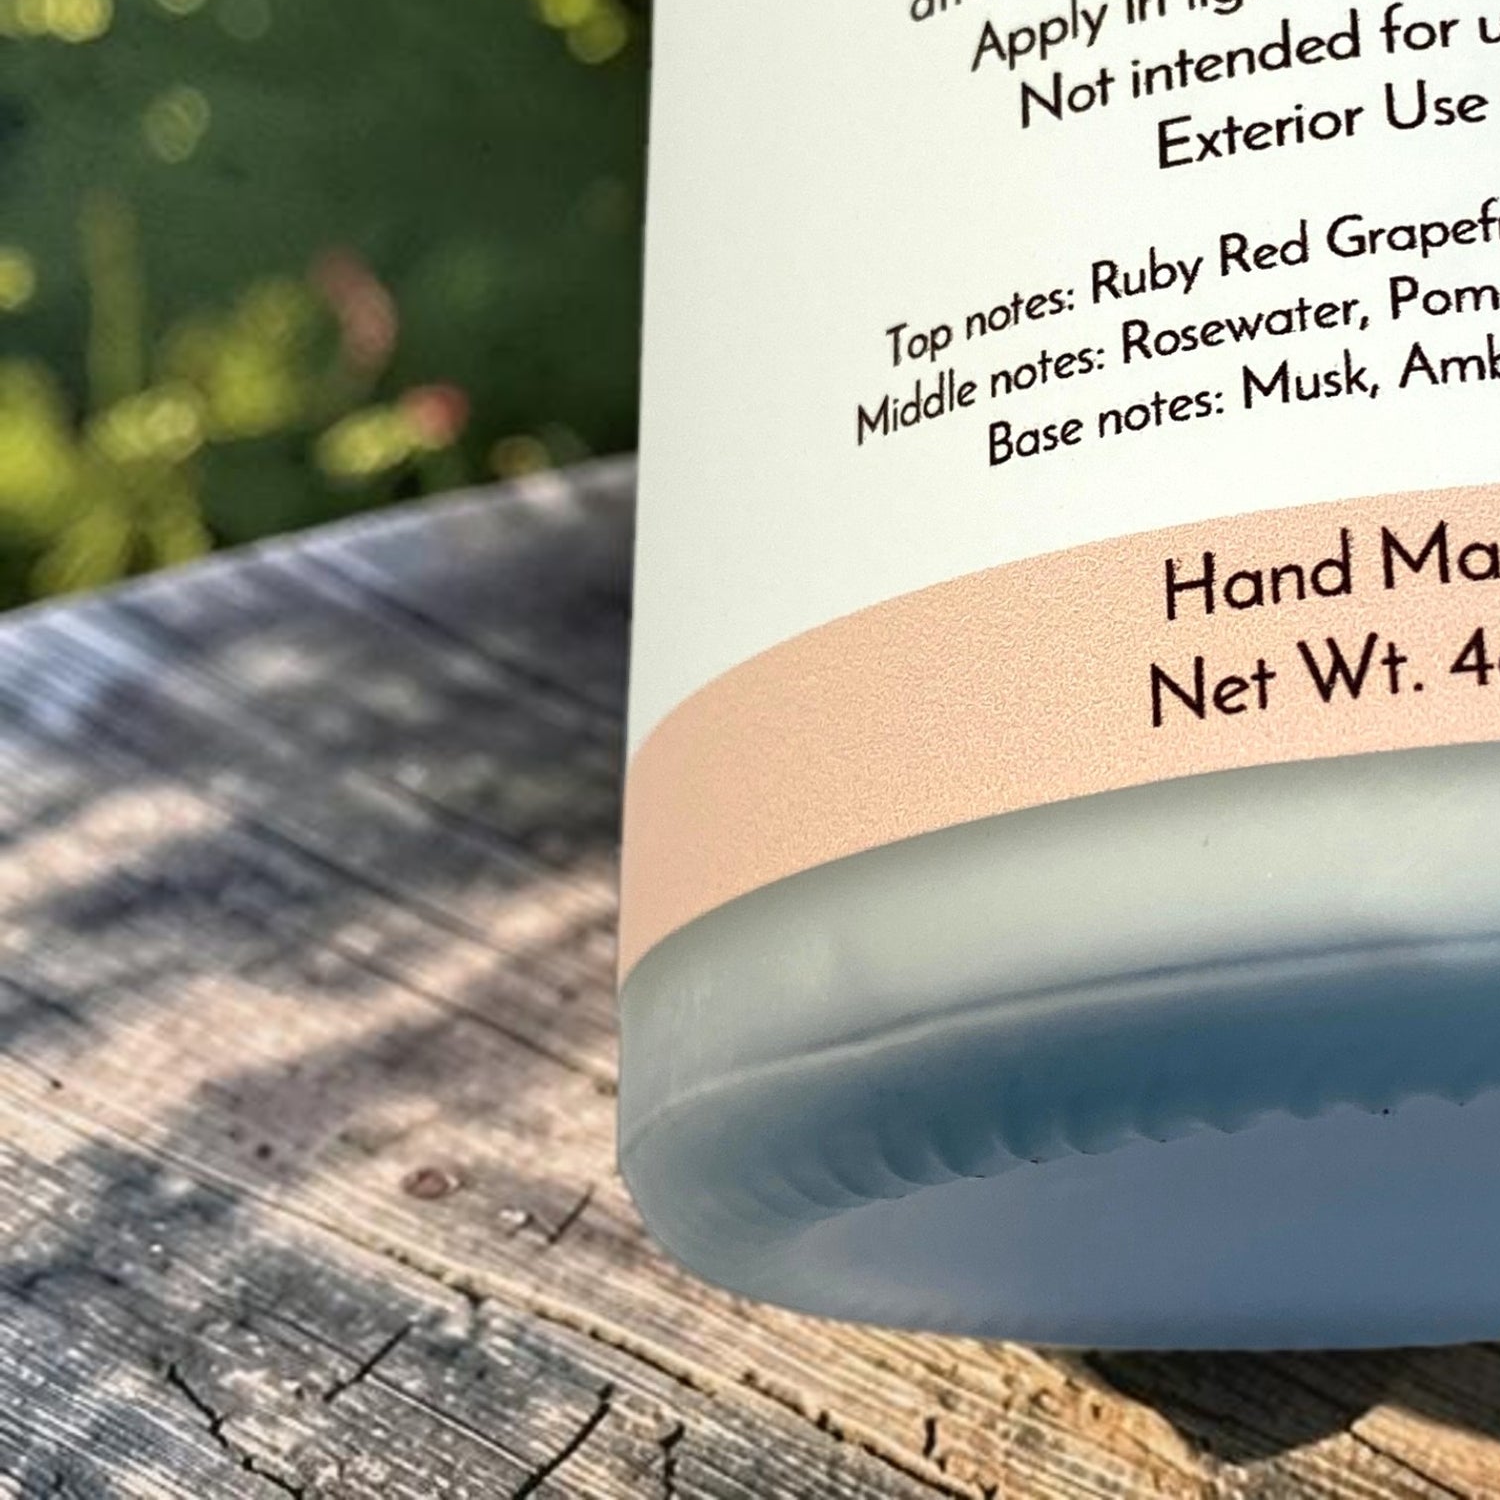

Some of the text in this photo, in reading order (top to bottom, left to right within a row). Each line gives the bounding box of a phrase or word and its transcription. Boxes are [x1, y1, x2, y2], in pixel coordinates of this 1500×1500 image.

[1019, 66, 1117, 131] Not
[1130, 6, 1362, 100] intended
[1378, 0, 1461, 55] for
[1156, 102, 1366, 171] Exterior
[1383, 77, 1491, 131] Use
[884, 321, 955, 368] Top
[964, 287, 1076, 342] notes:
[1090, 244, 1205, 306] Ruby
[1218, 217, 1311, 278] Red
[856, 366, 979, 448] Middle
[989, 346, 1106, 400] notes:
[1120, 295, 1371, 366] Rosewater,
[987, 417, 1085, 468] Base
[1097, 389, 1226, 440] notes:
[1240, 347, 1382, 411] Musk,
[1163, 525, 1356, 623] Hand
[1148, 654, 1278, 729] Net
[1294, 630, 1425, 705] Wt.
